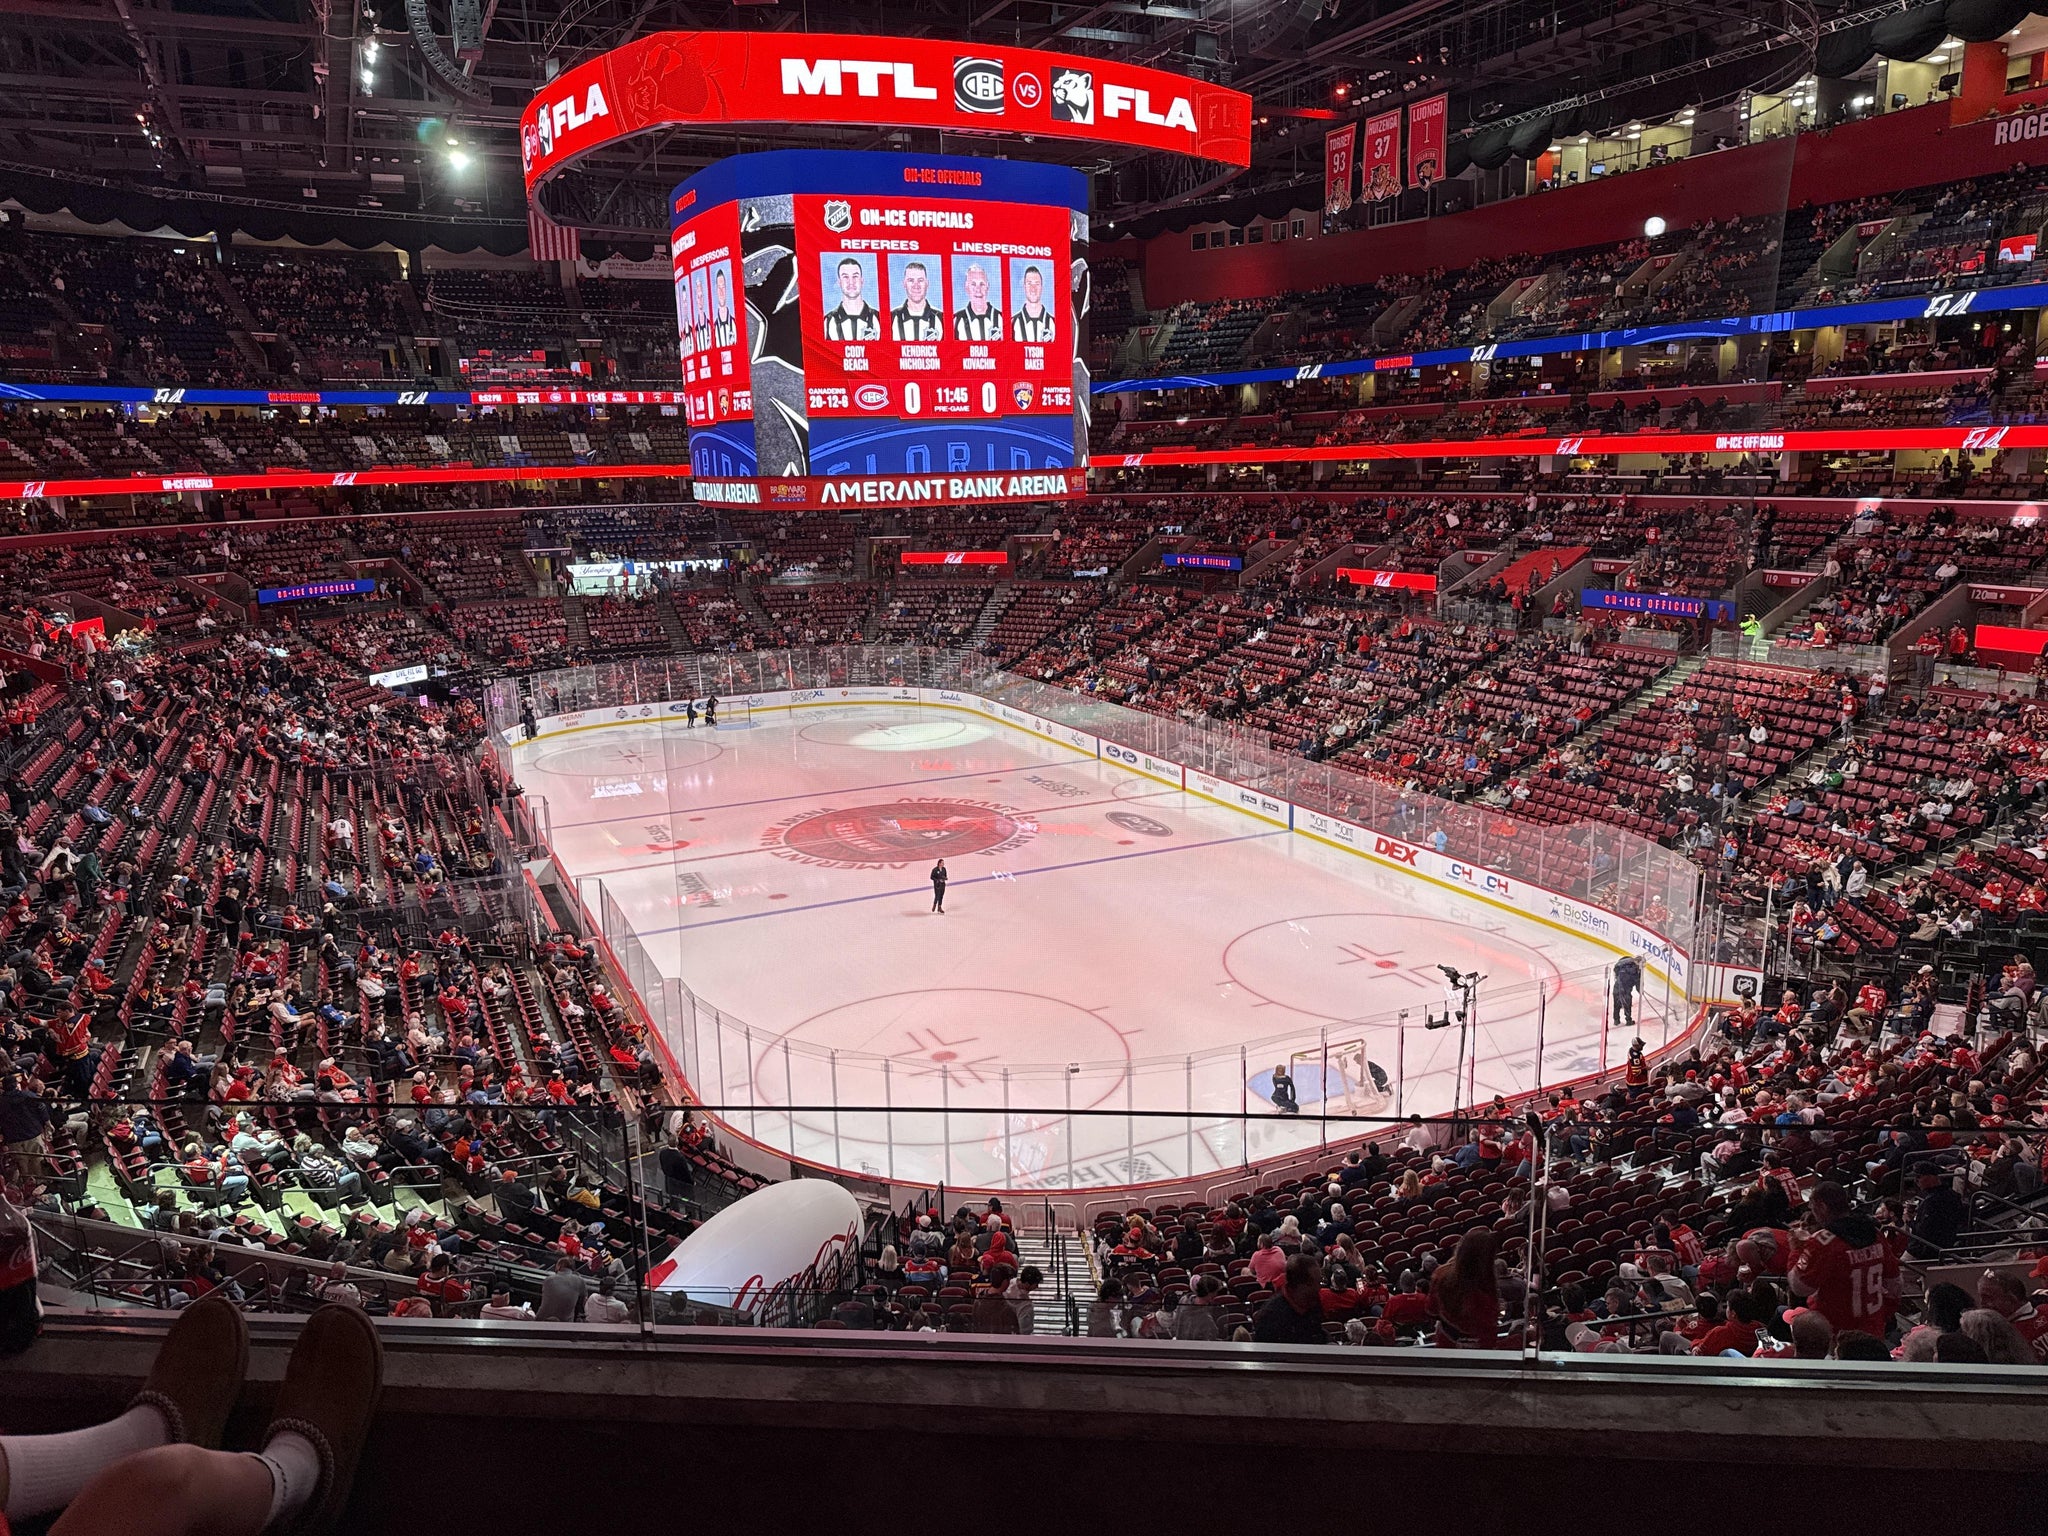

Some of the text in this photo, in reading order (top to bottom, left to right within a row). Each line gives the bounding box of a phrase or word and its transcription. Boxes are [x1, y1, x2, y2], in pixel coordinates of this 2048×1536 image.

[780, 58, 937, 100] MTL
[1019, 84, 1036, 97] VS
[552, 83, 609, 139] FLA
[1103, 84, 1197, 133] FLA
[1412, 100, 1443, 122] LUONGO
[1368, 115, 1398, 136] HUIZENGA
[1423, 121, 1430, 144] 1
[1330, 133, 1351, 152] TORREY
[1374, 135, 1391, 159] 37
[1333, 151, 1346, 174] 93
[904, 167, 982, 186] ON-ICE OFFICIALS
[830, 209, 848, 228] NHL
[860, 209, 974, 229] ON-ICE OFFICIALS
[1861, 225, 1874, 236] 318
[840, 239, 919, 251] REFEREES
[953, 241, 1052, 257] LINESPERSONS
[845, 346, 865, 358] CODY
[901, 345, 937, 358] KENDRICK
[969, 346, 988, 358] BRAD
[1024, 346, 1044, 358] TYSON
[843, 358, 869, 371] BEACH
[900, 358, 941, 371] NICHOLSON
[962, 358, 996, 371] KOVACHIK
[1024, 358, 1044, 371] BAKER
[268, 392, 321, 403] ON-ICE OFFICIALS
[810, 395, 849, 408] 20-12-6
[904, 382, 921, 414] 0
[936, 387, 968, 404] 11:45
[981, 381, 997, 414] 0
[1042, 393, 1071, 406] 21-15-2
[934, 405, 970, 413] PRE-GAME
[1715, 436, 1742, 449] ON-ICE
[162, 478, 214, 489] ON-ICE OFFICIALS
[821, 474, 1068, 503] AMERANT BANK ARENA
[725, 483, 762, 503] ARENA
[1177, 556, 1231, 568] ON-ICE OFFICIALS
[1765, 574, 1778, 585] 119
[277, 582, 357, 599] ON-ICE OFFICIALS
[1604, 594, 1700, 614] ON-ICE OFFICIAL
[558, 712, 586, 723] AMERANT
[565, 720, 580, 728] BANK
[1166, 766, 1180, 777] Health
[1196, 774, 1220, 788] AMERANT
[760, 807, 837, 847] BANK ARENA
[771, 850, 909, 870] AMERANT
[1375, 837, 1419, 866] DEX
[1451, 863, 1473, 881] CH
[1486, 875, 1509, 894] CH
[1563, 903, 1609, 932] BioStem
[1641, 938, 1683, 977] HONDA
[1851, 1263, 1885, 1318] 19
